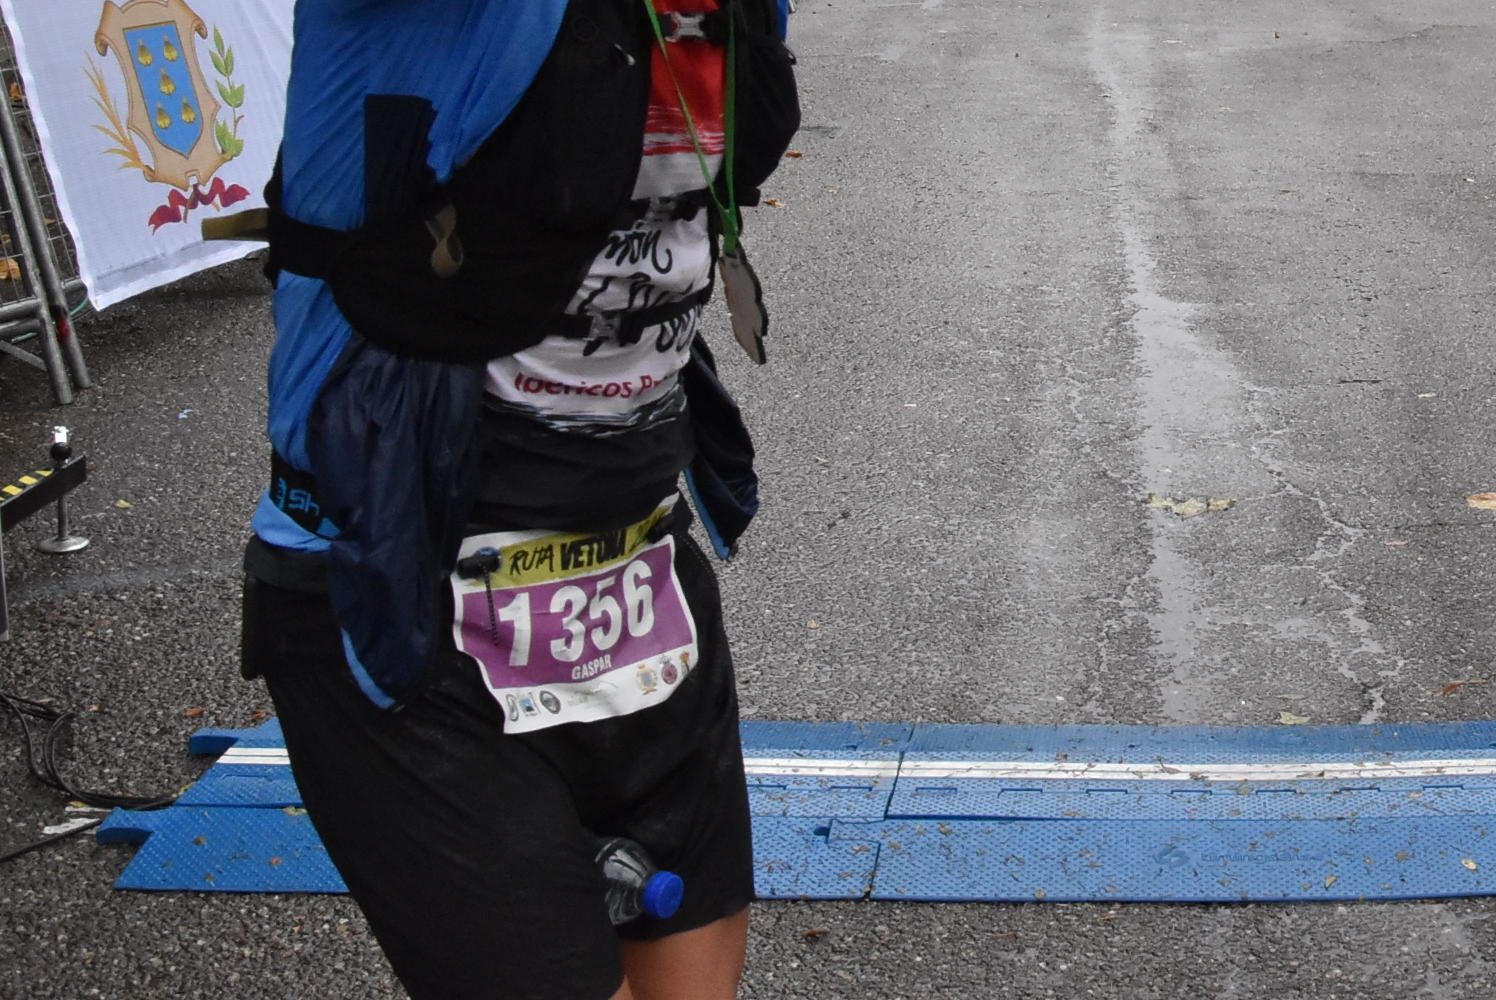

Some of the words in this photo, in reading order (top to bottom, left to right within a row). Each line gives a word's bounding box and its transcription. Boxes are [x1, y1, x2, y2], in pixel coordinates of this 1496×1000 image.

[510, 543, 555, 576] RUTA
[498, 559, 655, 667] 1356
[571, 653, 613, 680] GASPAR
